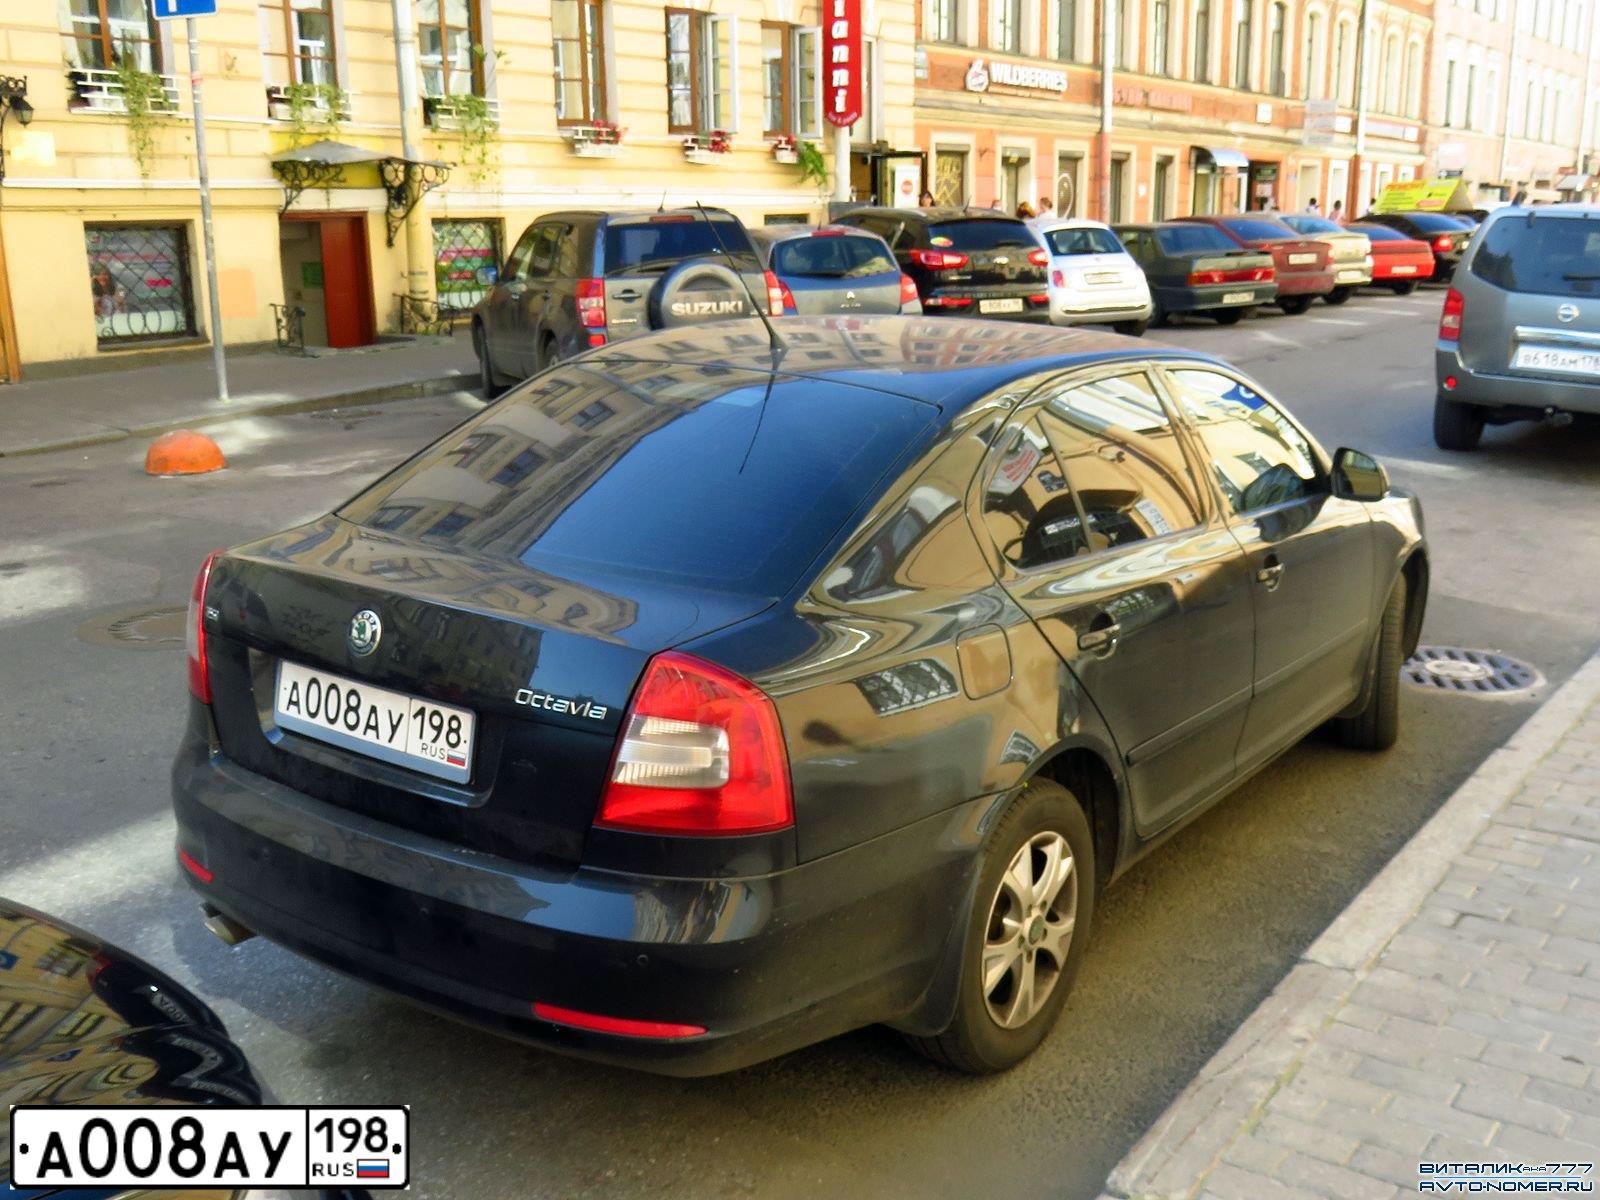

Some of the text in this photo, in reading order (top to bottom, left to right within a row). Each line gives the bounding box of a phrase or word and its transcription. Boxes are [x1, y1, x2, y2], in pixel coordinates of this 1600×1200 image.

[990, 61, 1068, 92] WILDBERRIES
[671, 300, 743, 316] SUZUKI
[286, 677, 462, 749] А008АУ 198
[514, 688, 608, 720] Octavia
[421, 742, 446, 761] RUS
